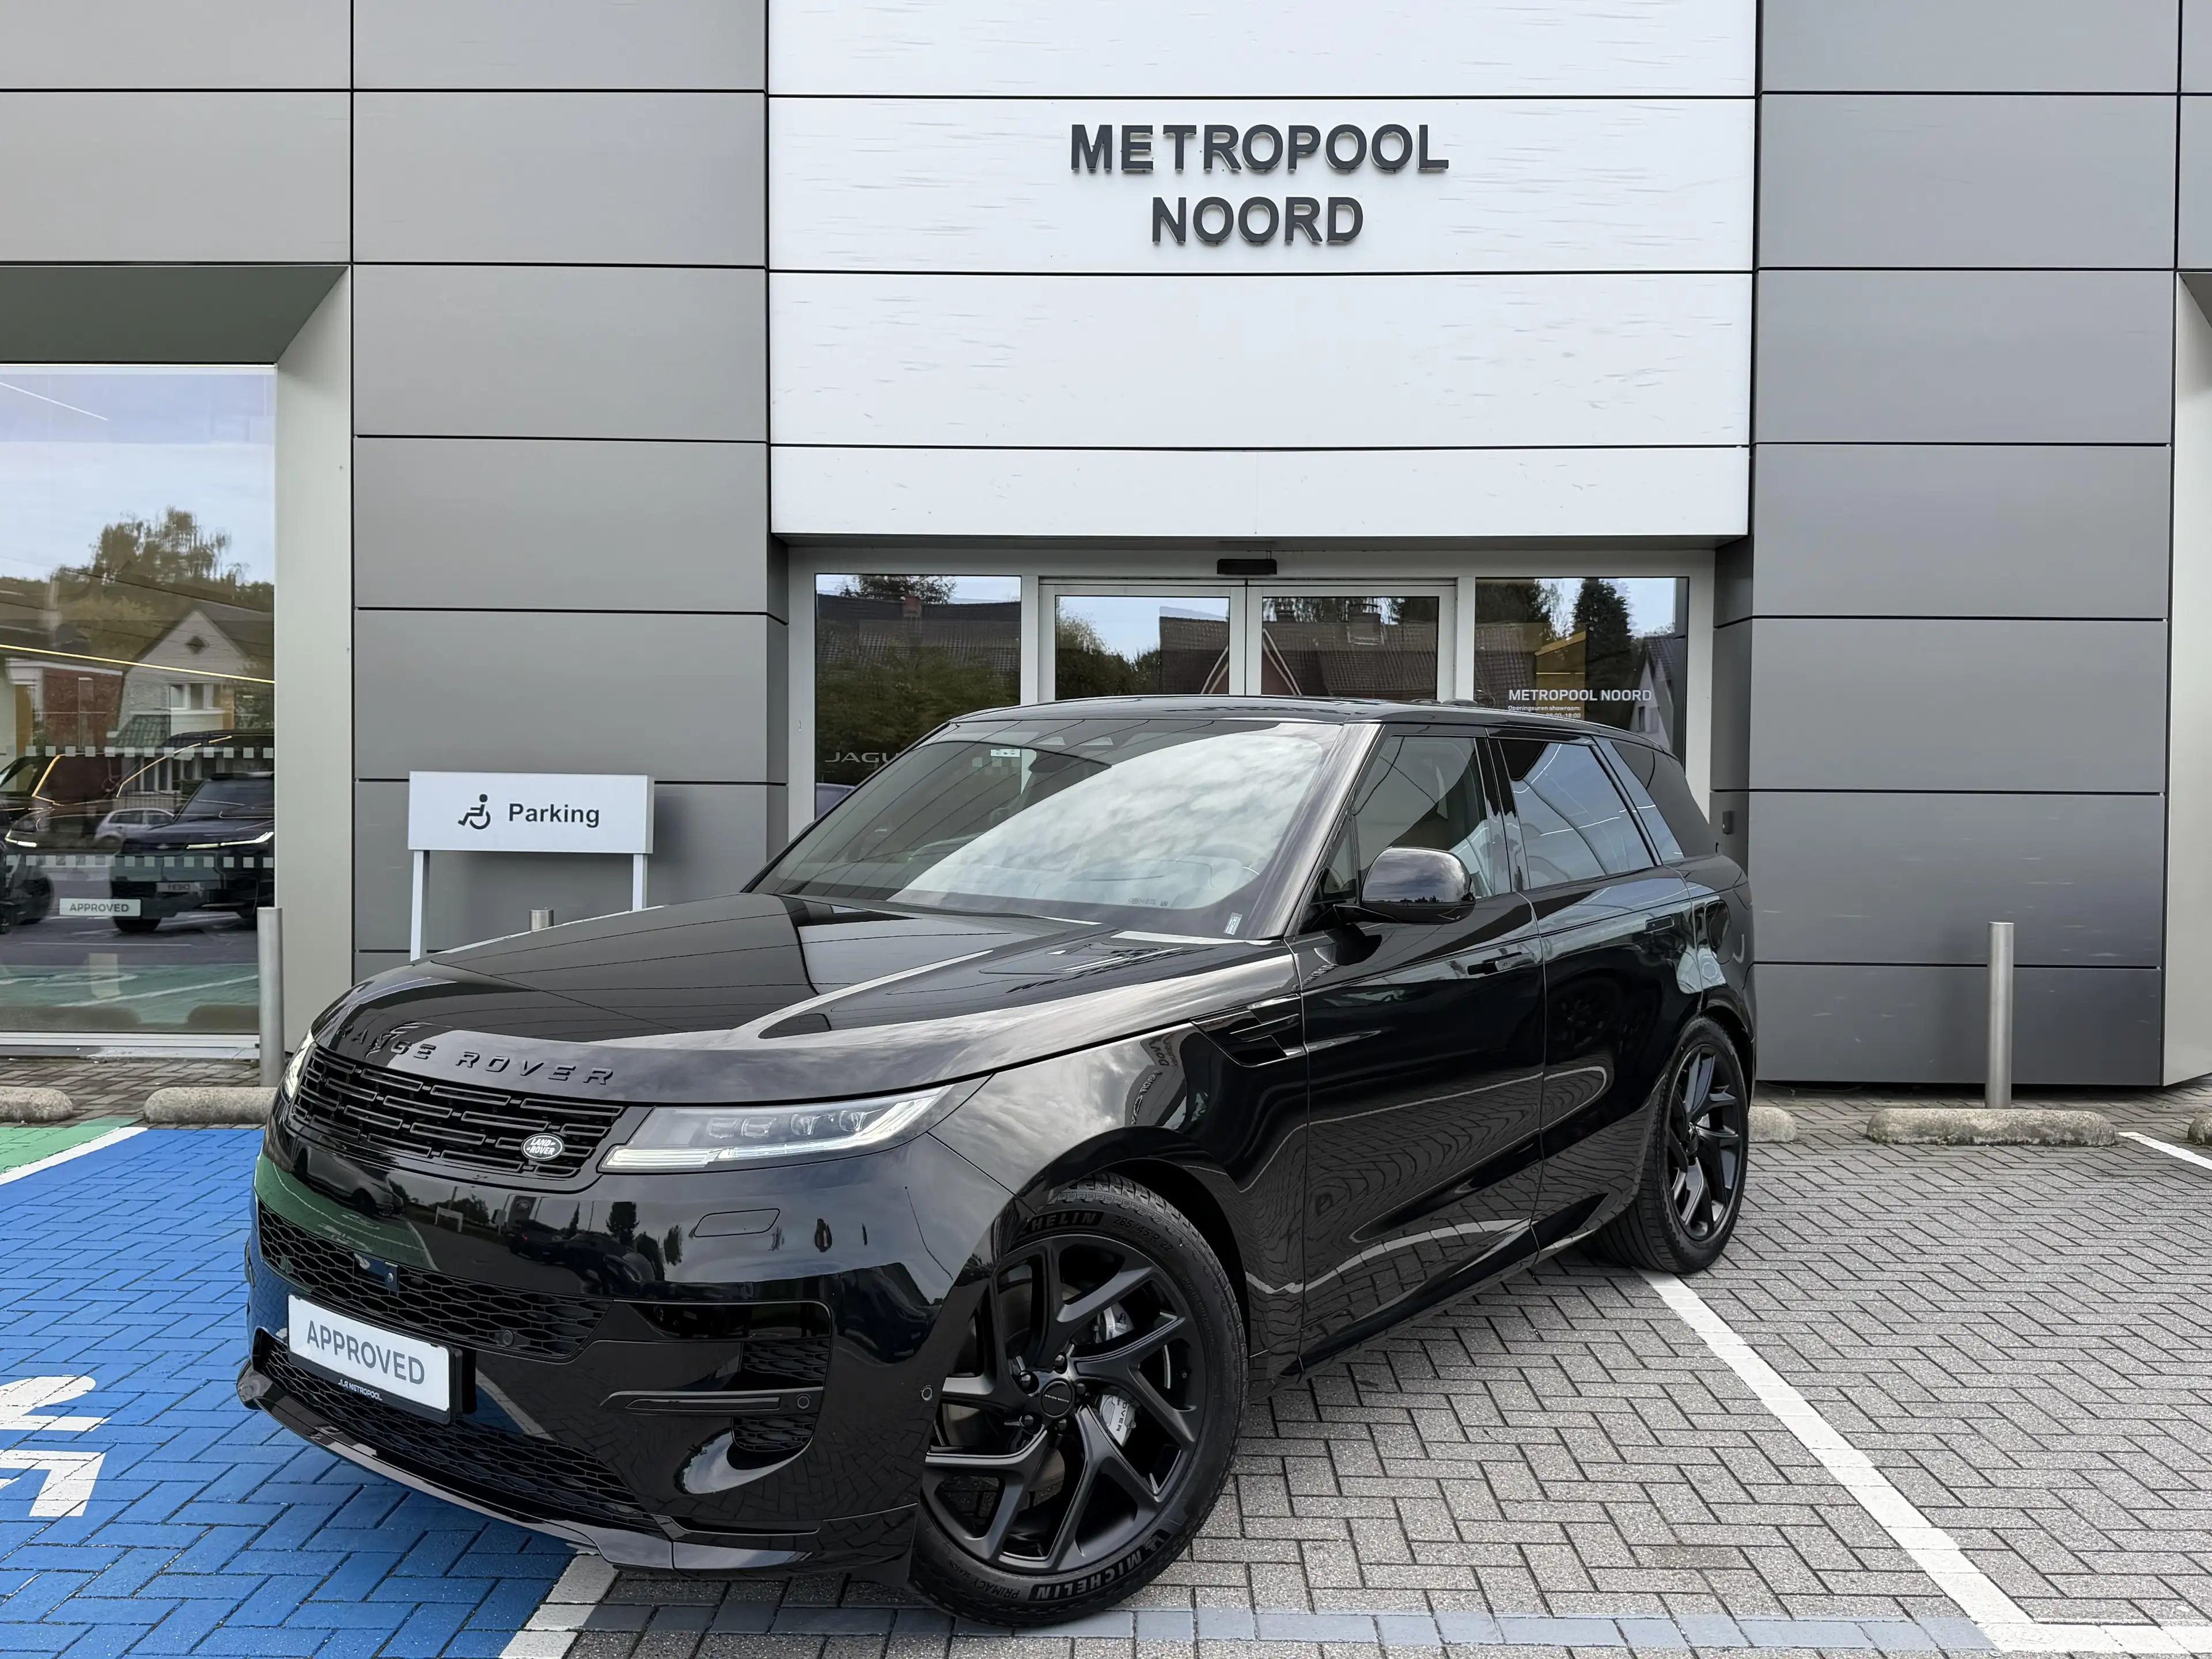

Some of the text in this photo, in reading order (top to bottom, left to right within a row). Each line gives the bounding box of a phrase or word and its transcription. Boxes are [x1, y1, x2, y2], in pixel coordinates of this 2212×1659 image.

[1071, 124, 1449, 171] METROPOOL
[1152, 196, 1363, 244] NOORD
[1509, 689, 1652, 702] METROPOOL NOORD
[825, 752, 900, 763] JAGU
[509, 803, 599, 828] Parking
[69, 903, 129, 912] APPROVED
[336, 1024, 613, 1085] RANGE ROVER
[529, 1145, 555, 1156] ROVER
[530, 1138, 552, 1147] LAND
[1024, 1212, 1097, 1233] HELIN
[1113, 1215, 1150, 1237] 285/45
[1160, 1241, 1173, 1252] 22
[307, 1320, 425, 1385] APPROVED
[338, 1378, 382, 1401] JLR METROPOOL
[1116, 1402, 1127, 1431] OVER
[1036, 1550, 1142, 1599] MICHELIN
[972, 1578, 1020, 1599] PRIMACY
